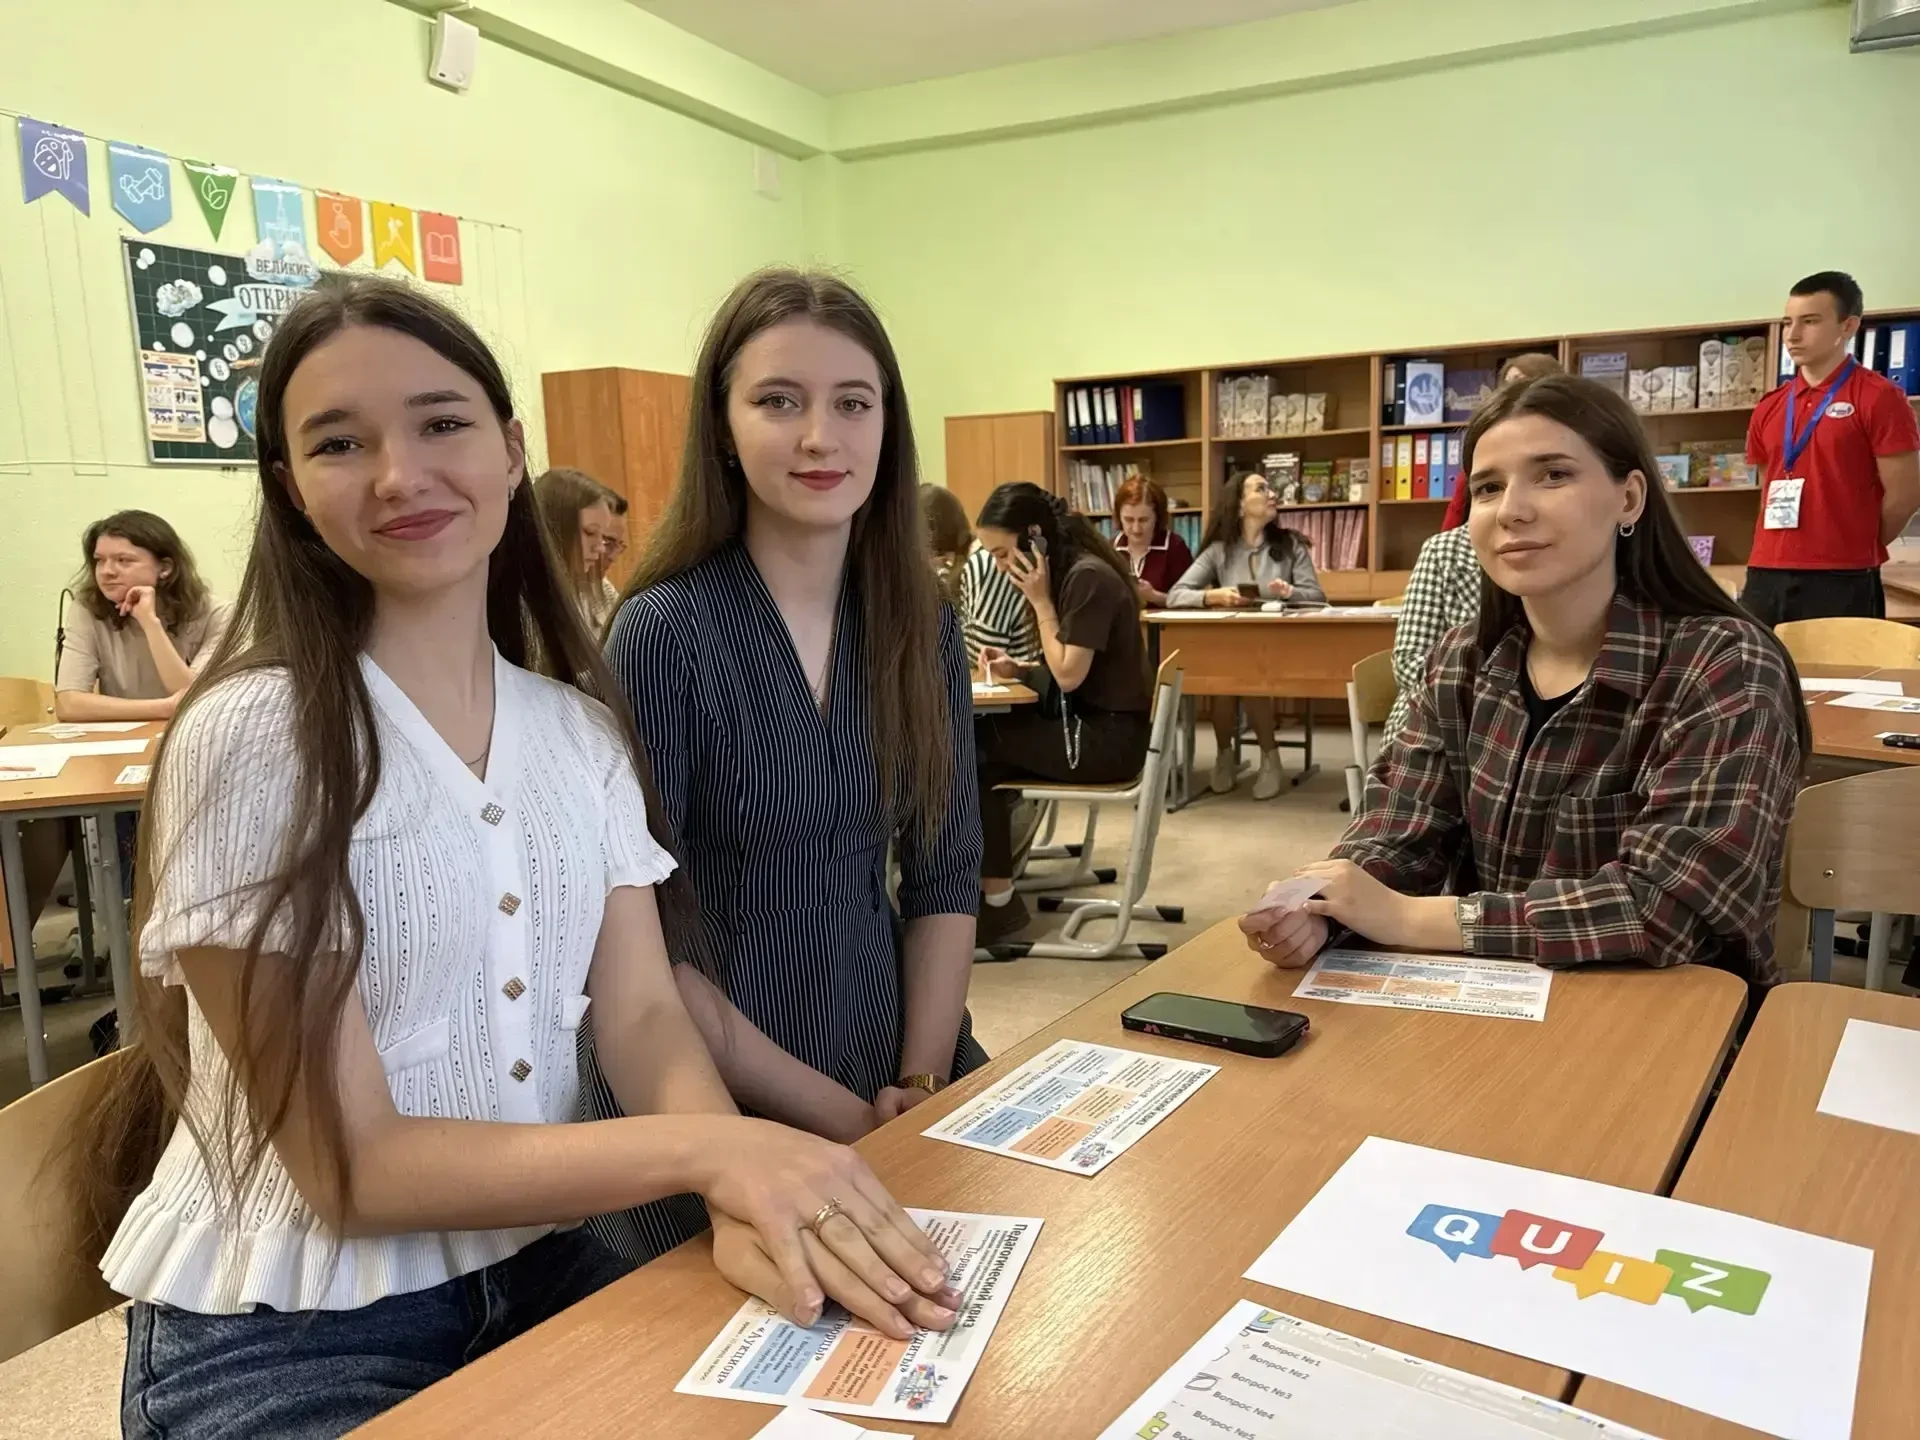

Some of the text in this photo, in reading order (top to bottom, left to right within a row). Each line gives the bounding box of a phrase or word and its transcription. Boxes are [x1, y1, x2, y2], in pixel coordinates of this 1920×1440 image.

[256, 258, 310, 276] ВЕЛИКИЕ
[240, 286, 300, 310] ОТКРЫ
[950, 1247, 978, 1282] Первый
[976, 1224, 1028, 1301] Педагогический
[1433, 1213, 1729, 1298] QUIZ
[962, 1302, 984, 1328] квиз
[716, 1326, 765, 1384] «Аукцион»
[900, 1328, 928, 1372] удиты»
[1261, 1340, 1300, 1360] Вопрос
[1301, 1355, 1321, 1368] №1
[1249, 1353, 1310, 1381] Вопрос №2
[1231, 1372, 1293, 1400] Вопрос №3
[1212, 1391, 1276, 1421] Вопрос №4
[1192, 1410, 1233, 1432] Вопрос
